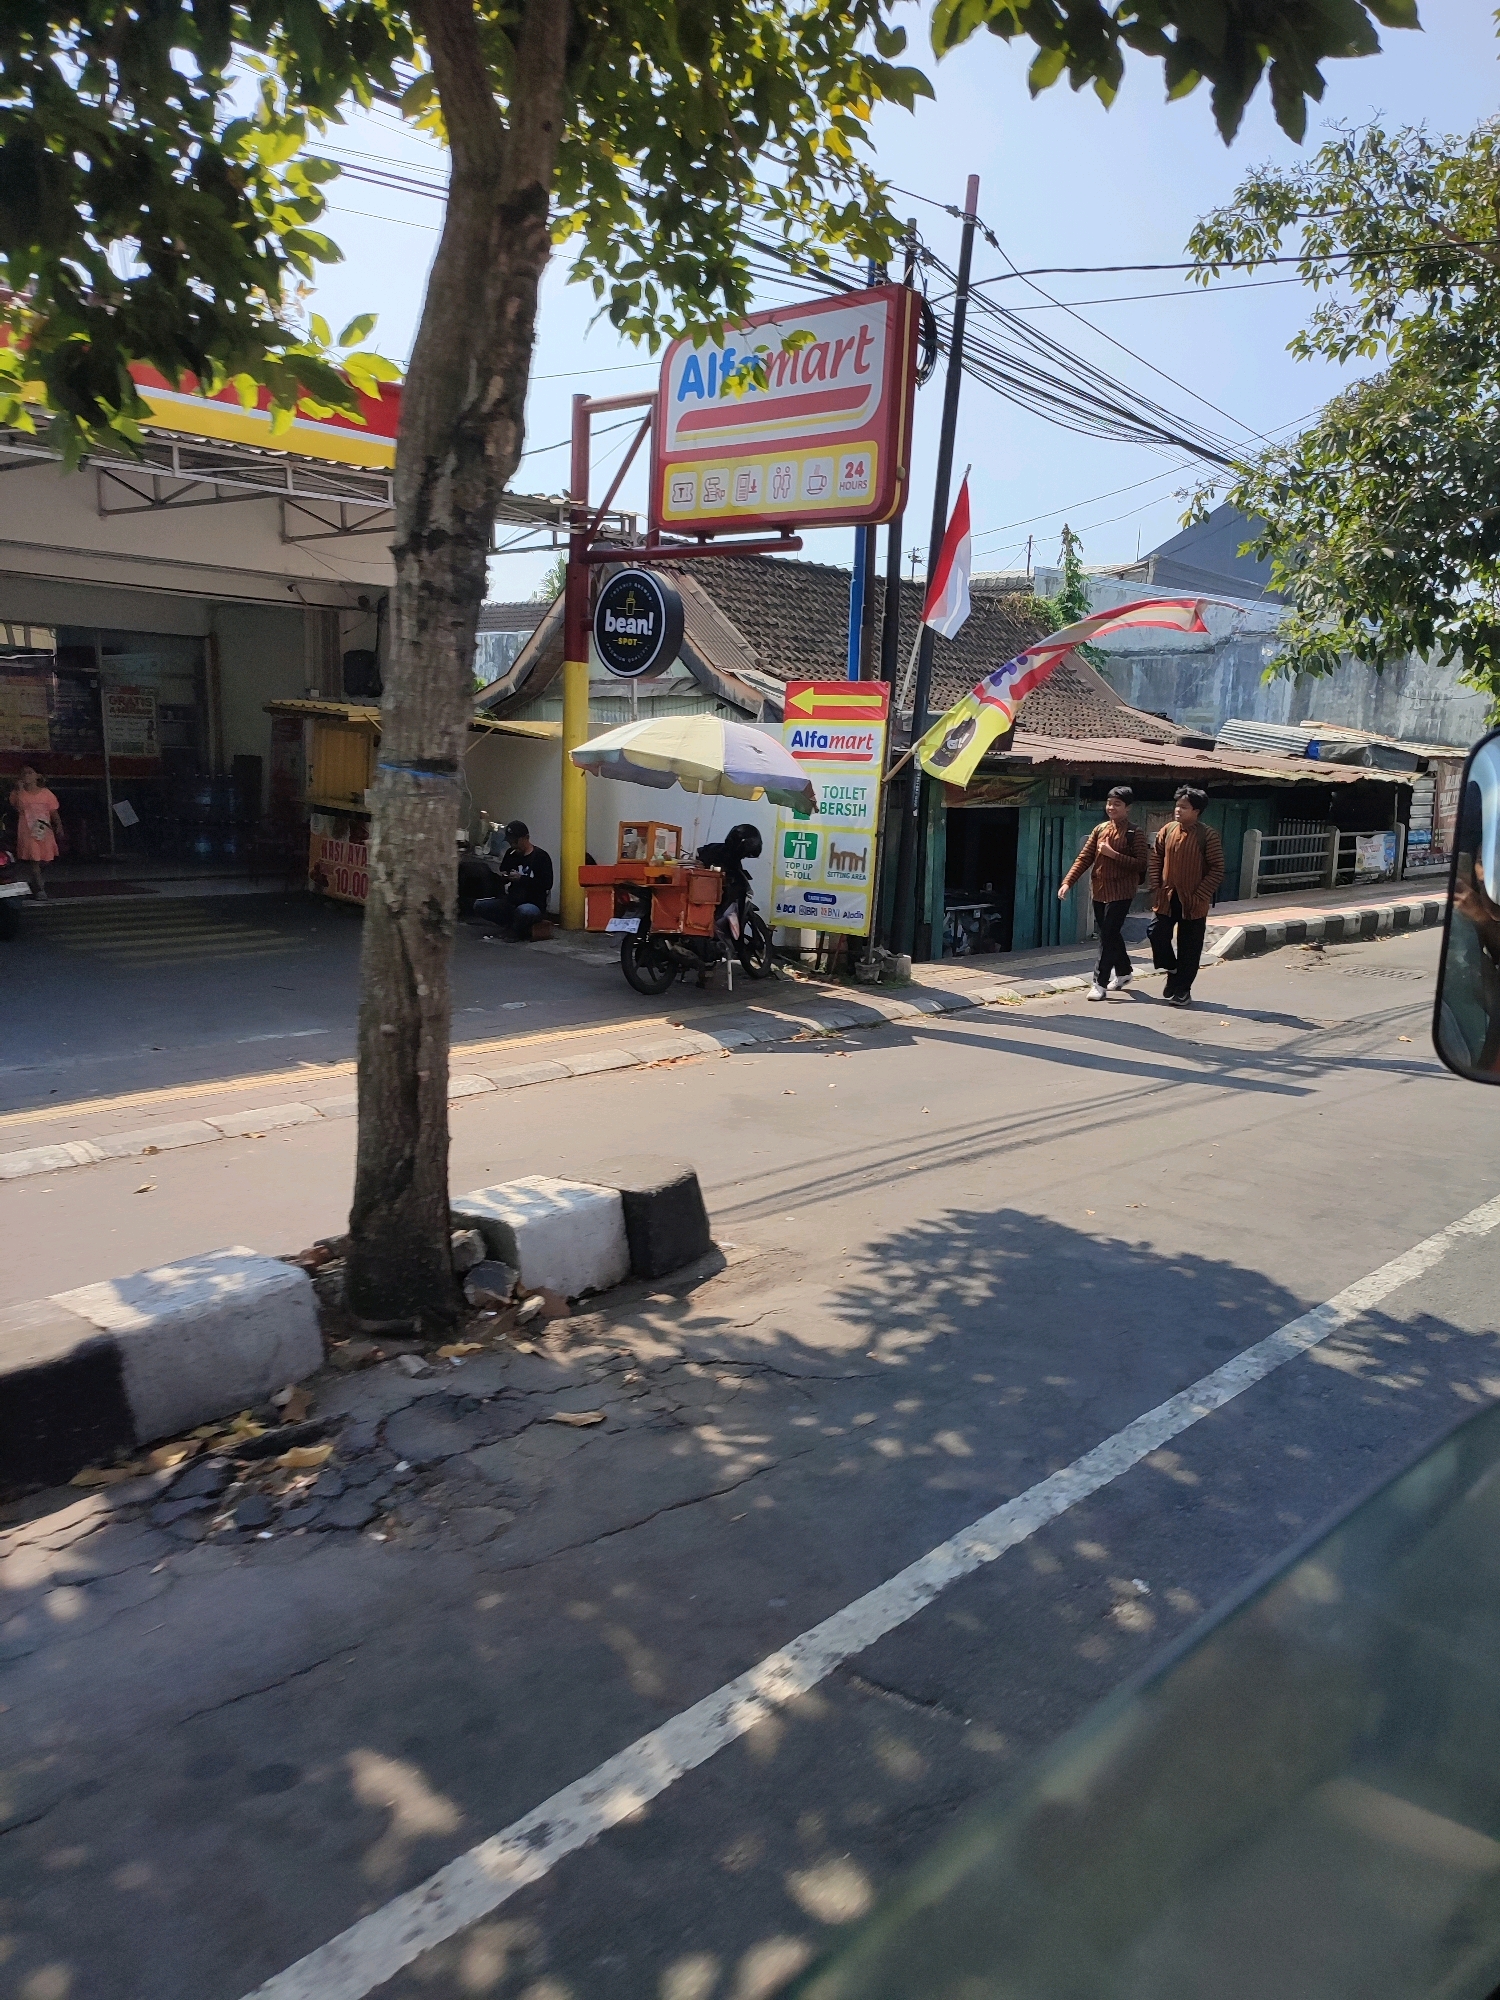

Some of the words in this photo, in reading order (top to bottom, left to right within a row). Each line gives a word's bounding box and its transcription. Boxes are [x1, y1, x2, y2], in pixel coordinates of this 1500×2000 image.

[845, 461, 864, 479] 24
[839, 480, 868, 491] HOURS
[605, 609, 654, 635] bean!
[618, 637, 638, 646] SPOT
[791, 730, 874, 750] Alfamart
[822, 785, 867, 800] TOILET
[820, 801, 867, 817] BERSIH
[348, 844, 368, 867] AYA
[803, 863, 813, 871] UP
[785, 871, 811, 880] E-TOLL
[827, 871, 850, 879] SITTING
[335, 868, 369, 899] 10.00
